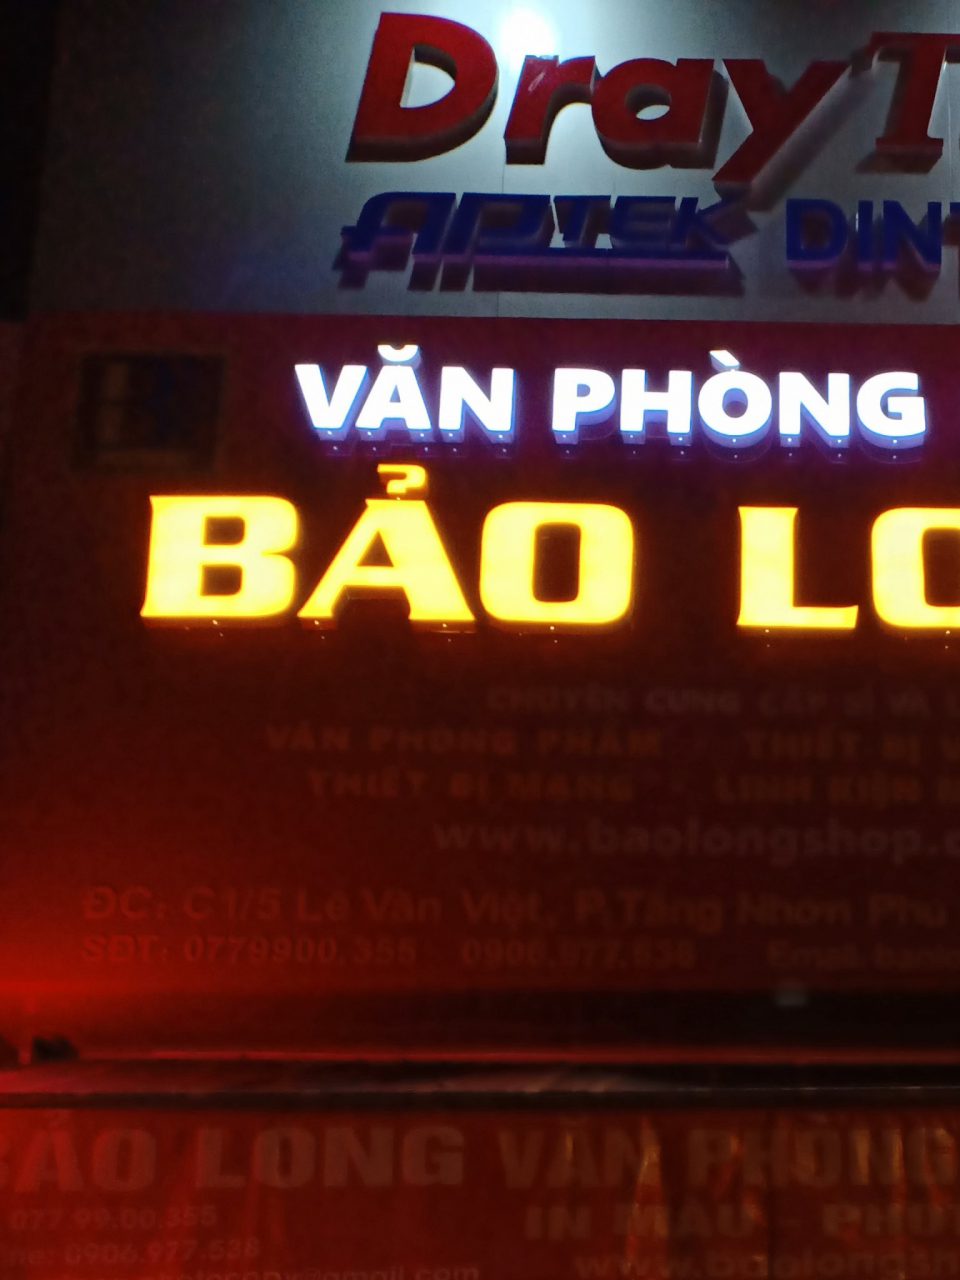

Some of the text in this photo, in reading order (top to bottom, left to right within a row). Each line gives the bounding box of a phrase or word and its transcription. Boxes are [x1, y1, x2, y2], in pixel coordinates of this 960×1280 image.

[293, 342, 520, 446] VĂN
[550, 348, 928, 450] PHÒNG
[141, 462, 635, 626] BẢO
[645, 689, 741, 716] CUNG
[0, 1108, 157, 1193] ẢO
[199, 1125, 467, 1189] LONG
[525, 1203, 592, 1241] IN
